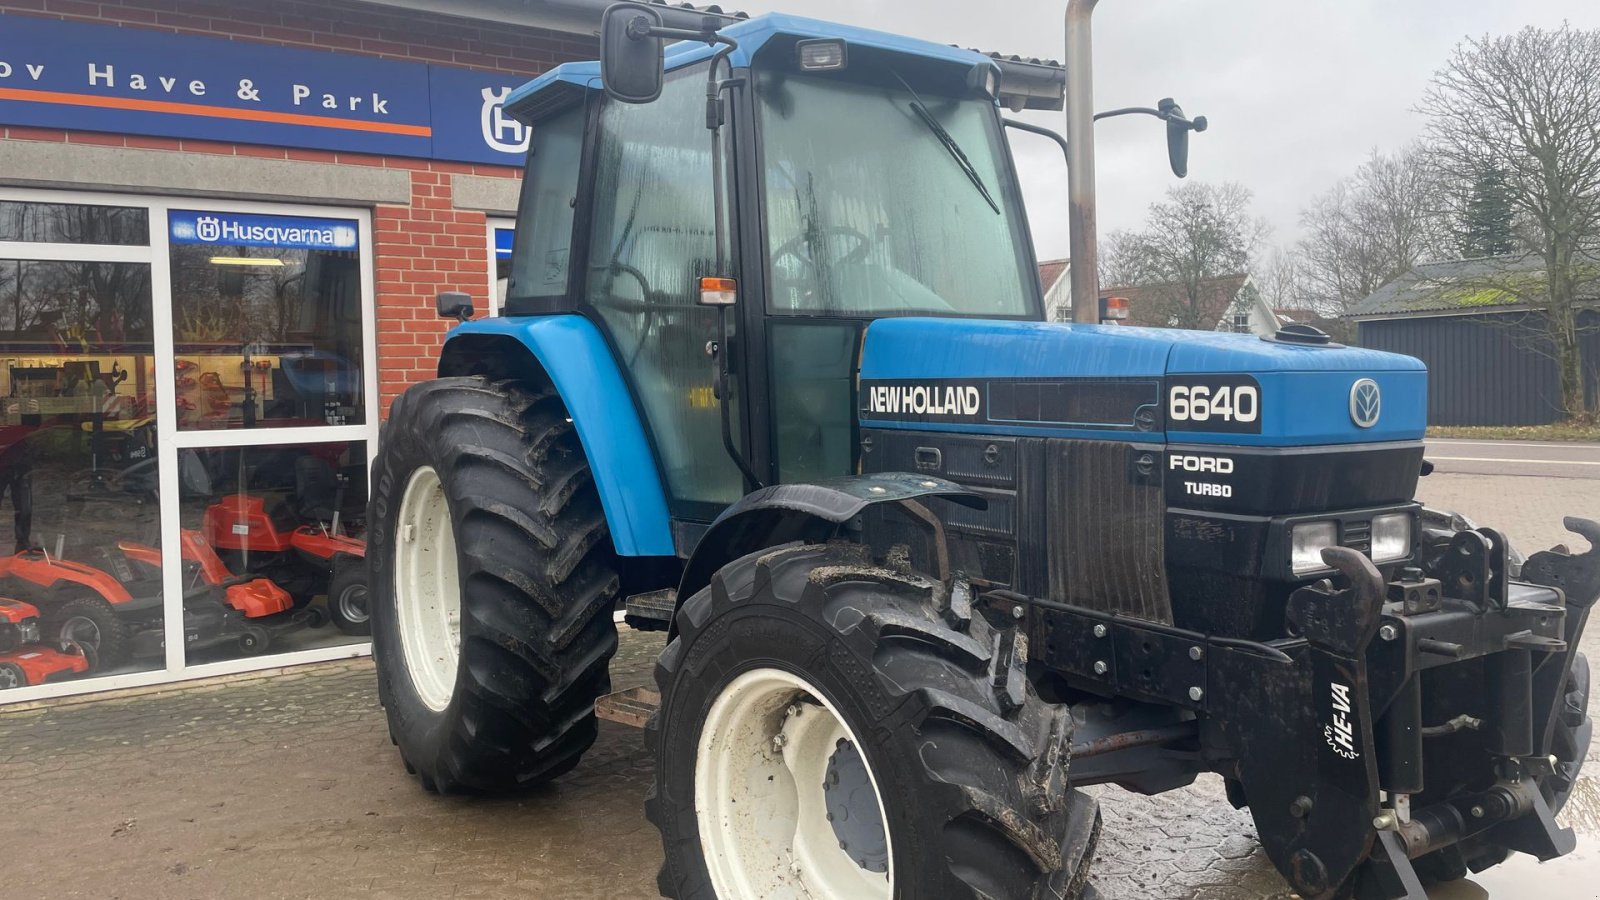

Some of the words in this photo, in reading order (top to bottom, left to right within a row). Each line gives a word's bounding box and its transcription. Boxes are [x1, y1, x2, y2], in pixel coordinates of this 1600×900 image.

[88, 63, 206, 96] Have
[237, 78, 262, 102] &
[293, 84, 389, 115] Park
[222, 220, 334, 245] Husqvarna
[870, 386, 901, 413] NEW
[902, 385, 980, 415] HOLLAND
[1169, 385, 1258, 422] 6640
[1169, 454, 1234, 474] FORD
[1184, 481, 1232, 498] TURBO
[1330, 682, 1354, 751] HE-VA
